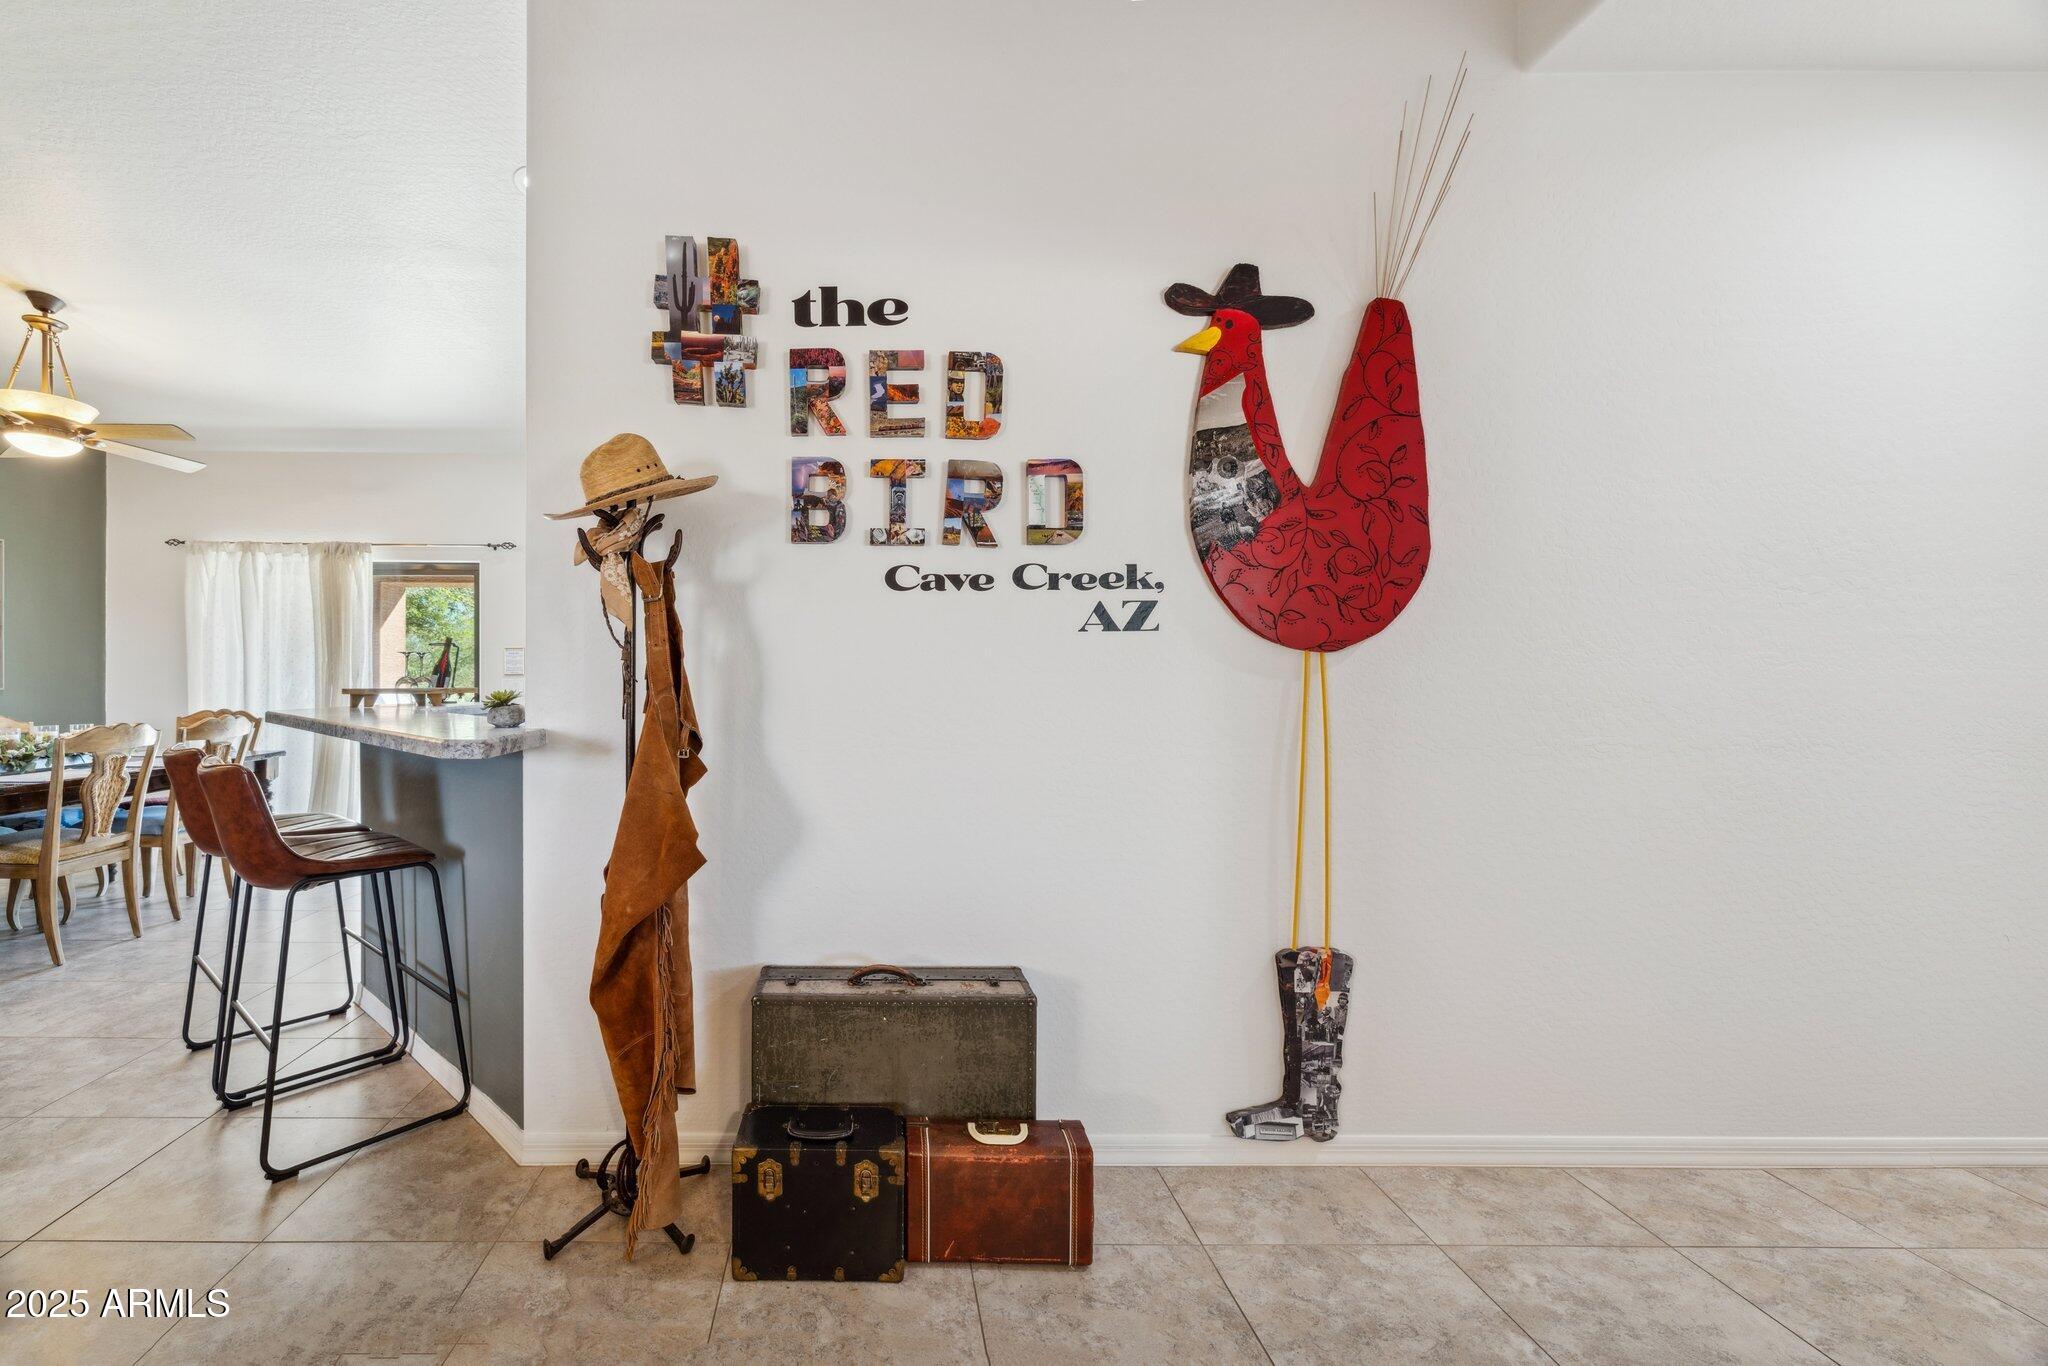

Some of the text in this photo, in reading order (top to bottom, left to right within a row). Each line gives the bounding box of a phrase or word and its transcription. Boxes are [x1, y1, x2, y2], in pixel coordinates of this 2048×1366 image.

[792, 286, 908, 327] the
[789, 348, 1003, 439] RED
[791, 456, 1083, 547] BIRD
[884, 563, 1165, 593] Cave Creek,
[1078, 600, 1159, 632] AZ
